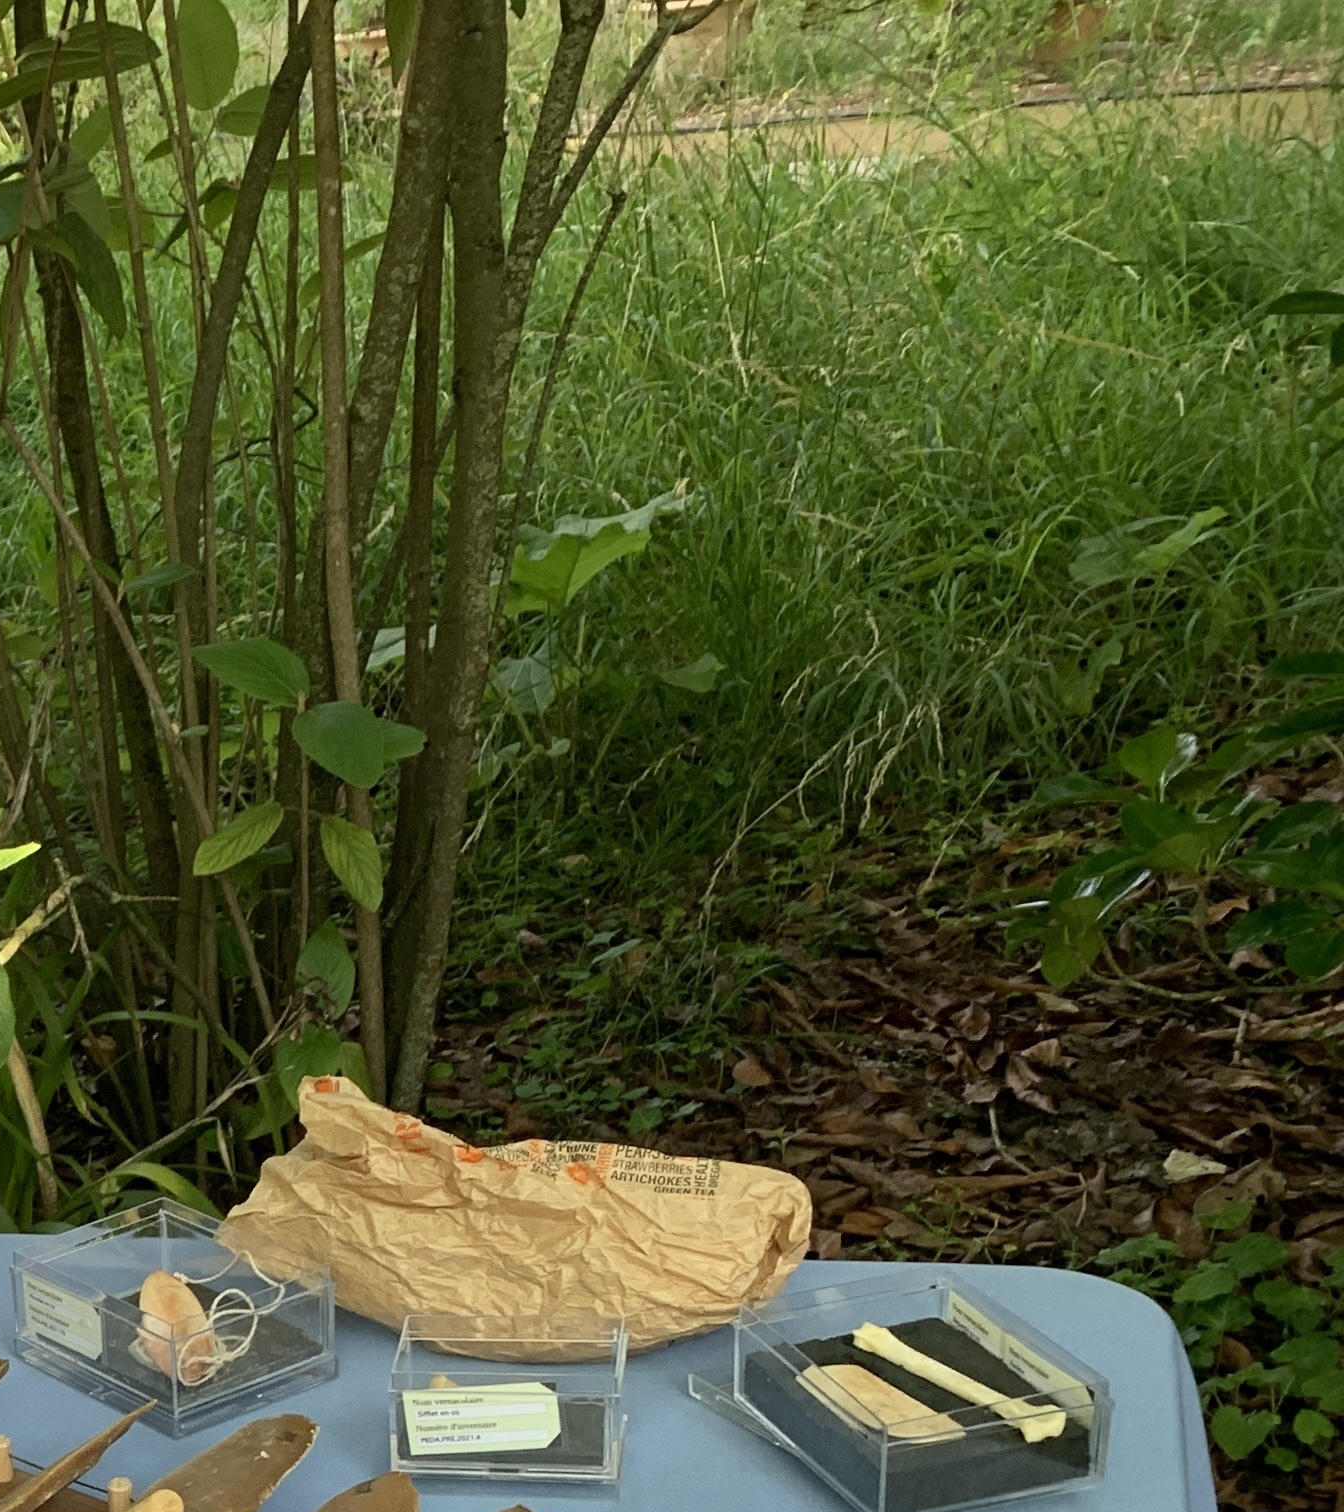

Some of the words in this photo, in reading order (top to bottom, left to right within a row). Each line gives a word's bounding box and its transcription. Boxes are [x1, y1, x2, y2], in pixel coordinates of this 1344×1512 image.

[558, 1143, 598, 1154] PRUNE
[612, 1159, 694, 1177] STRAWBERRIES
[611, 1170, 693, 1187] ARTICHOKES
[653, 1186, 692, 1195] GREEN
[695, 1187, 716, 1197] TEA
[434, 1396, 484, 1405] vernaculaire
[416, 1424, 448, 1432] Numéro
